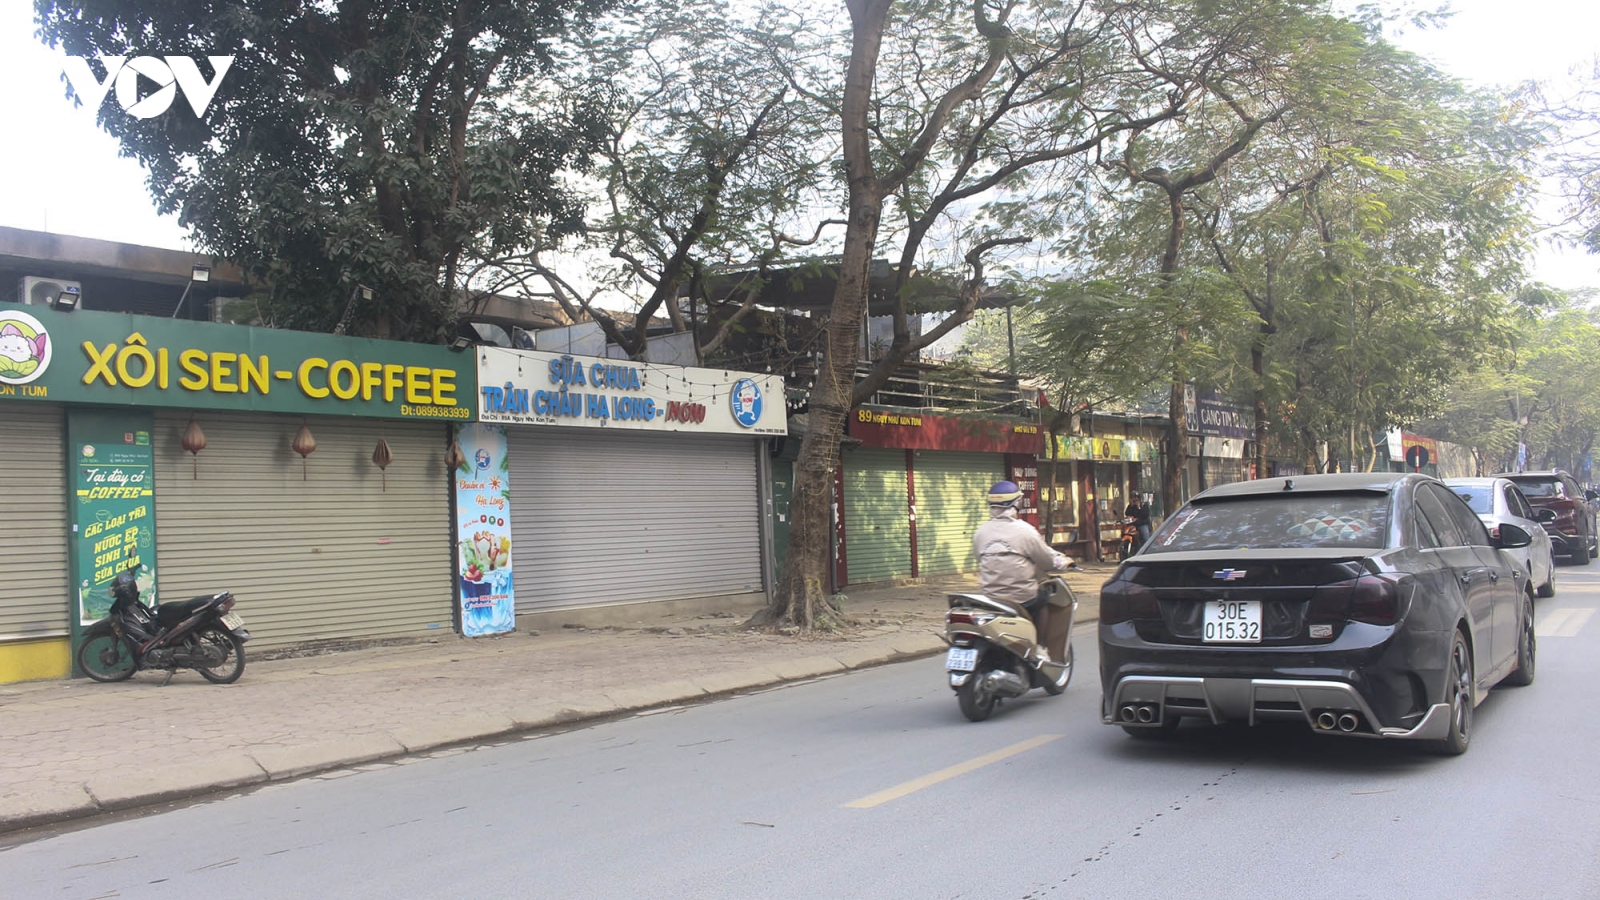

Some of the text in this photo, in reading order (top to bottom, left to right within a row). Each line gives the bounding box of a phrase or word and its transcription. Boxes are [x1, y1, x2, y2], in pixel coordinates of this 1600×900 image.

[81, 331, 169, 390] XÔI
[179, 349, 270, 395] SEN
[298, 357, 457, 406] COFFEE
[590, 363, 641, 391] CHUA
[21, 386, 48, 397] TUM
[481, 381, 529, 414] TRÂN
[532, 385, 583, 418] CHÂU
[585, 393, 610, 426] HẠ
[664, 400, 706, 425] NOW
[858, 409, 872, 423] 89
[86, 468, 145, 486] Tại đây có
[89, 487, 142, 499] COFFEE
[95, 548, 121, 568] SINH
[1217, 602, 1247, 620] 30E
[1205, 622, 1259, 640] 015.32
